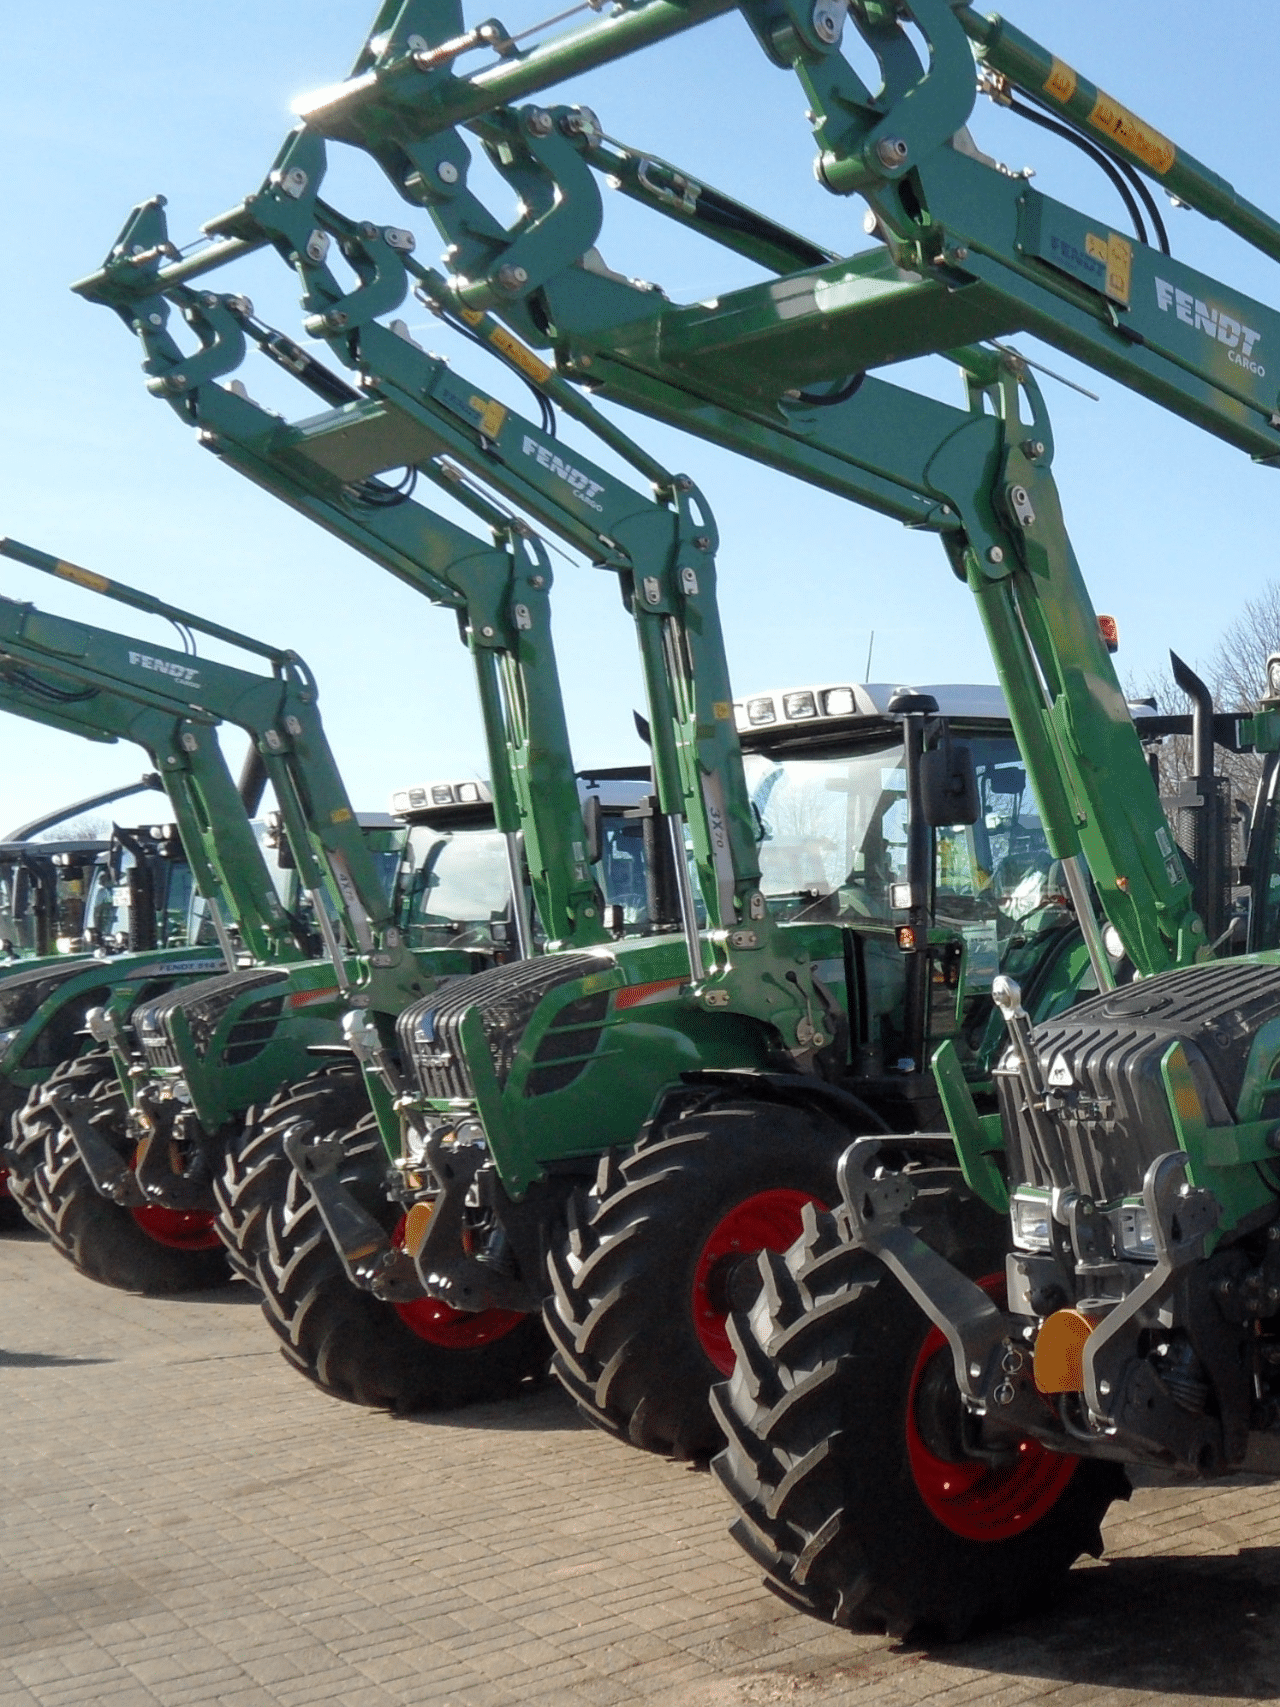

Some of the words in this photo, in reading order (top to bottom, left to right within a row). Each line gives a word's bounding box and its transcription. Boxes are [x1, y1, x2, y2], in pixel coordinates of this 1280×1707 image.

[1154, 276, 1261, 355] FENDT
[1227, 349, 1266, 377] CARGO
[522, 434, 605, 498] FENDT
[572, 489, 603, 512] CARGO
[128, 651, 199, 680] FENDT
[709, 807, 725, 849] 3X70
